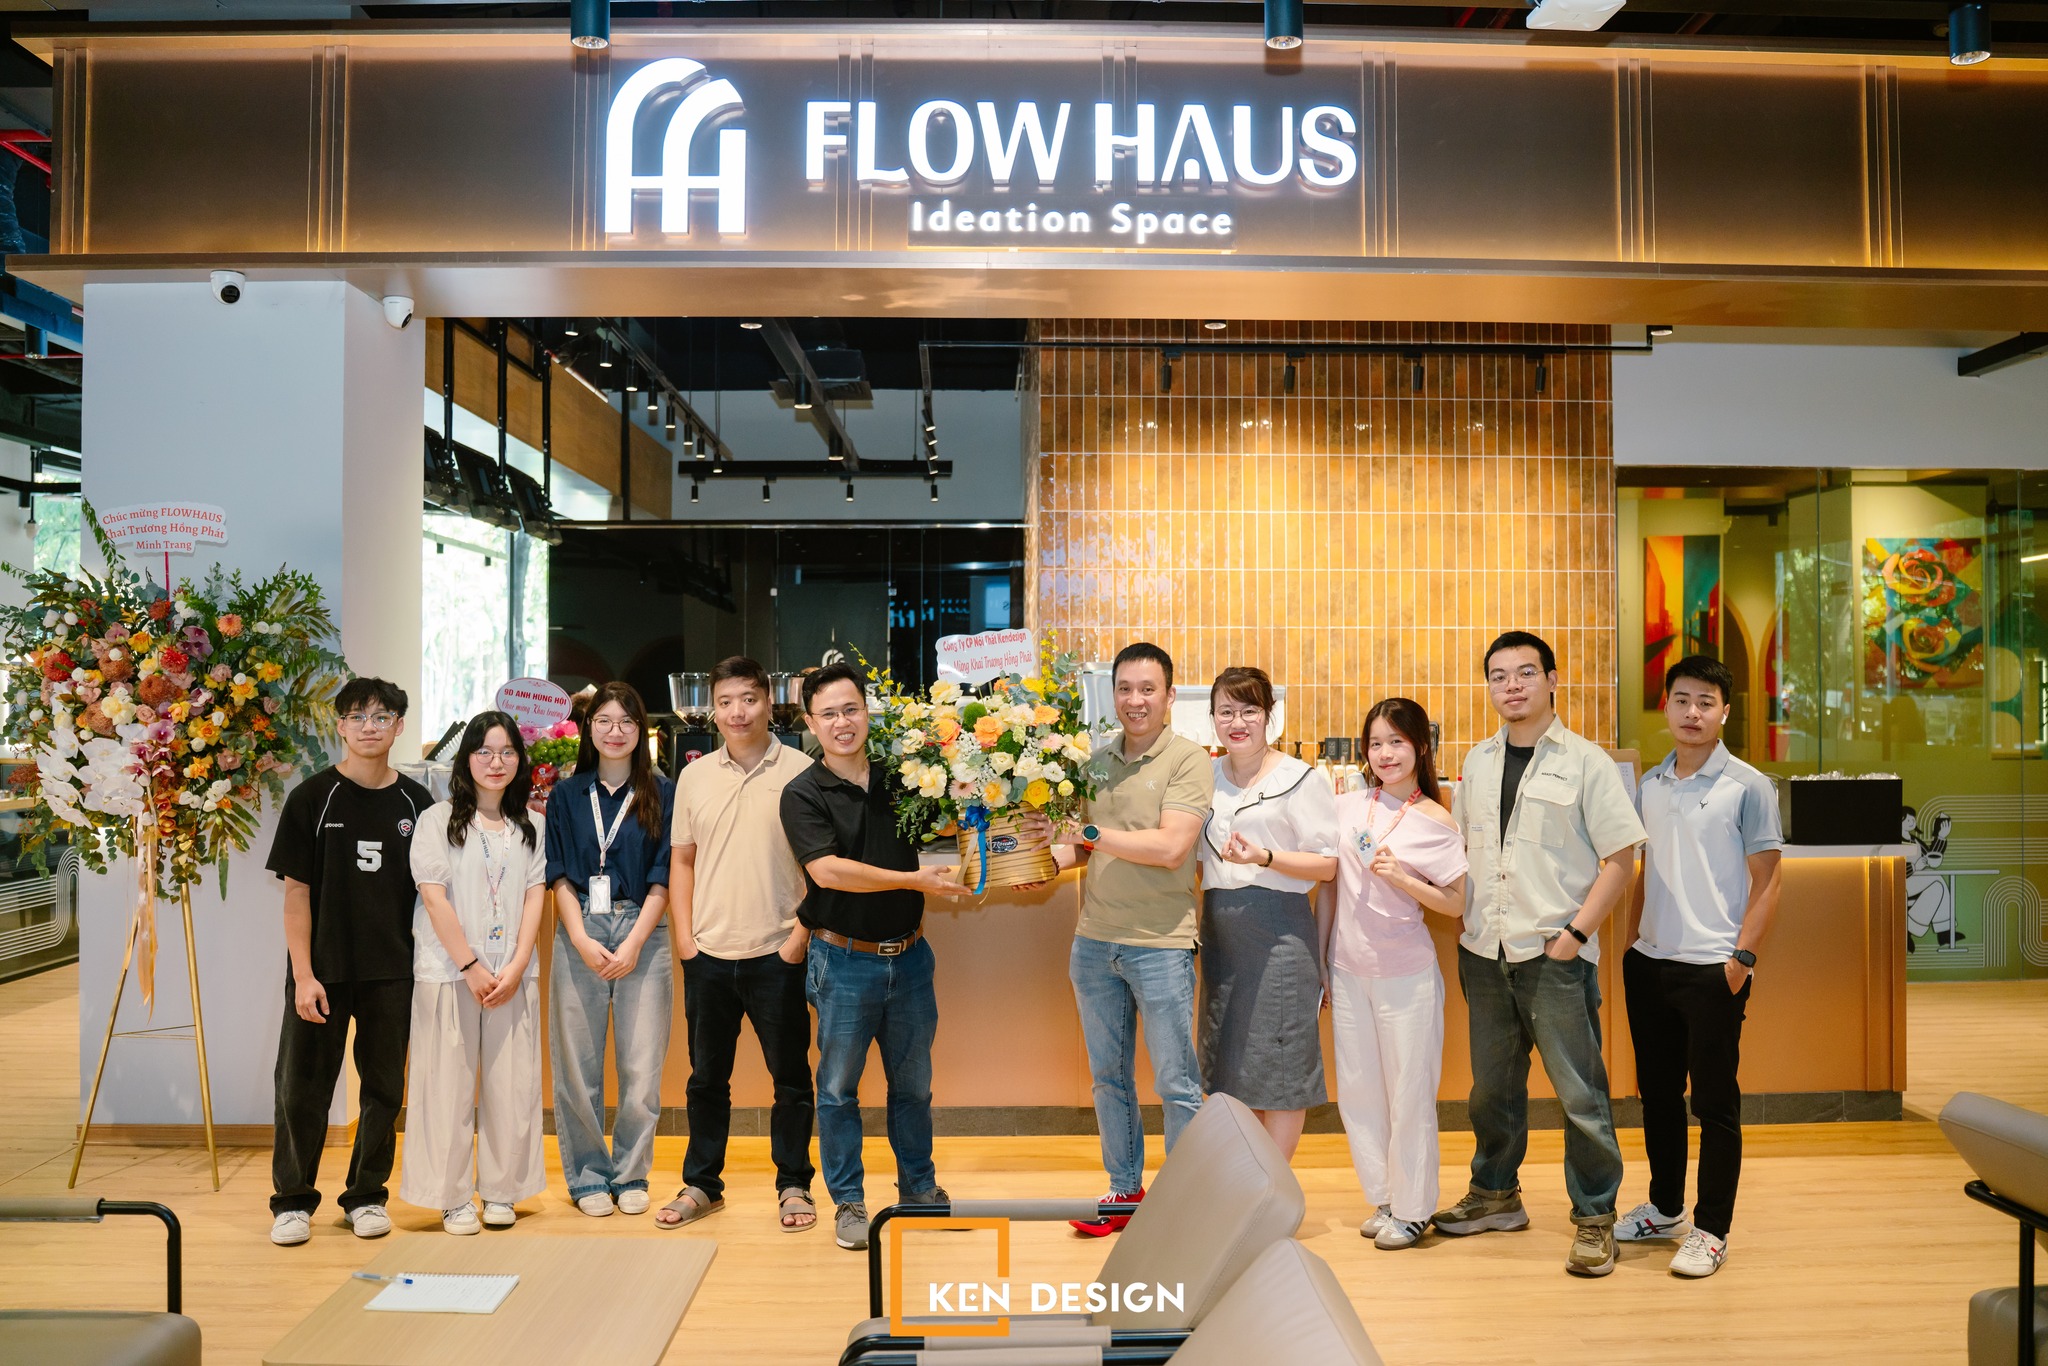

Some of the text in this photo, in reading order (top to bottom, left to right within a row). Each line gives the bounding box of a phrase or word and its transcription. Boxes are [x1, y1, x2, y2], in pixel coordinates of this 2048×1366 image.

[805, 100, 1358, 188] FLOW HAUS
[911, 199, 1233, 244] Ideation Space
[102, 508, 223, 525] Chúc mừng FLOWHAUS
[127, 524, 168, 535] Trương
[170, 522, 199, 536] Hồng
[200, 525, 225, 539] Phát
[136, 540, 192, 551] Minh Trang
[958, 639, 965, 651] Ty
[966, 637, 974, 648] CP
[997, 631, 1027, 643] Kendesign
[970, 657, 984, 670] Khai
[1019, 650, 1033, 663] Phát
[515, 690, 531, 699] ANH
[356, 840, 383, 873] 5
